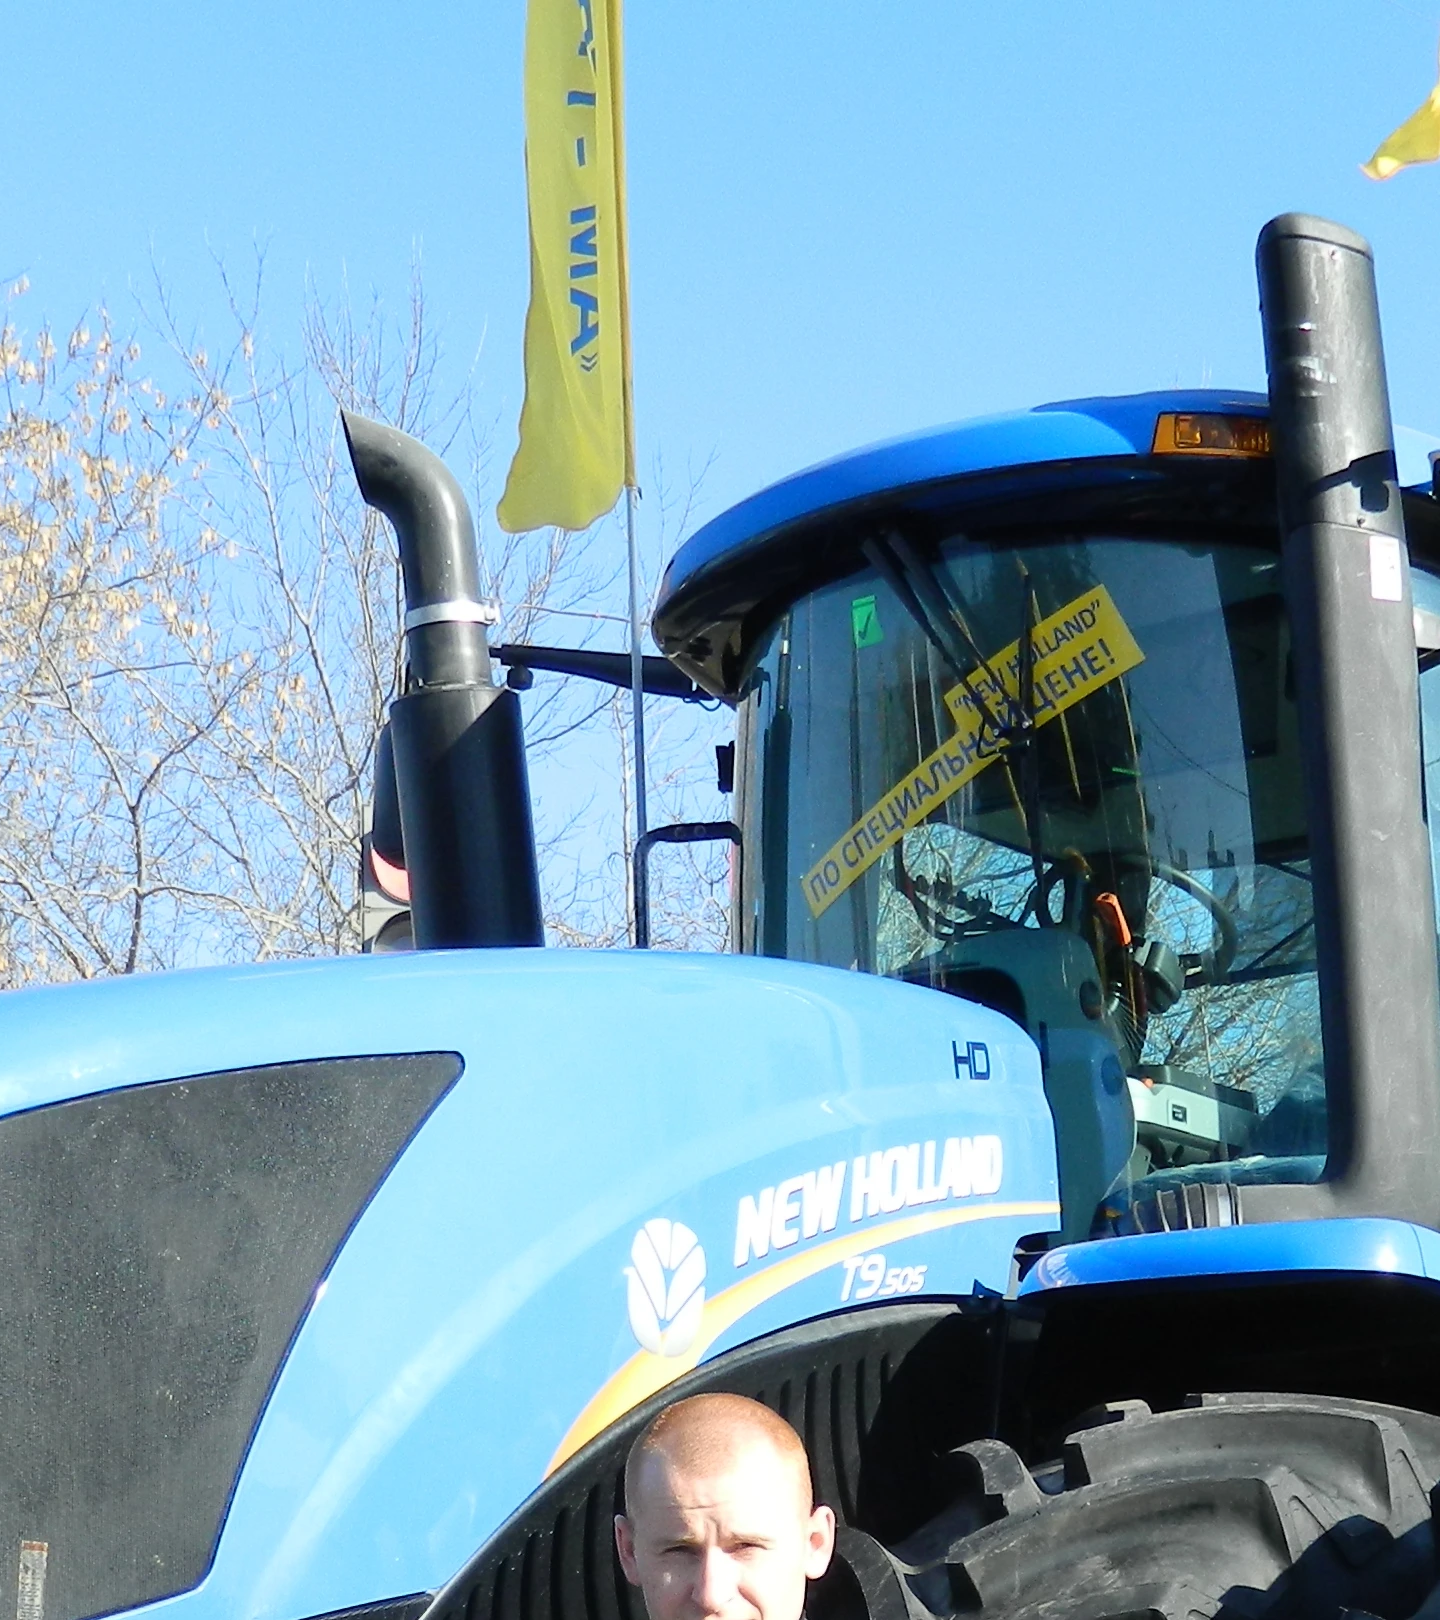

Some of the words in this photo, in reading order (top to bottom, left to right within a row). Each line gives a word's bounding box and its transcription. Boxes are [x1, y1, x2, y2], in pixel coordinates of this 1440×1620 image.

[810, 863, 840, 903] ПО
[1032, 637, 1116, 716] ЦЕНЕ!
[952, 1040, 991, 1081] HD
[733, 1161, 847, 1269] NEW
[849, 1135, 1004, 1223] HOLLAND
